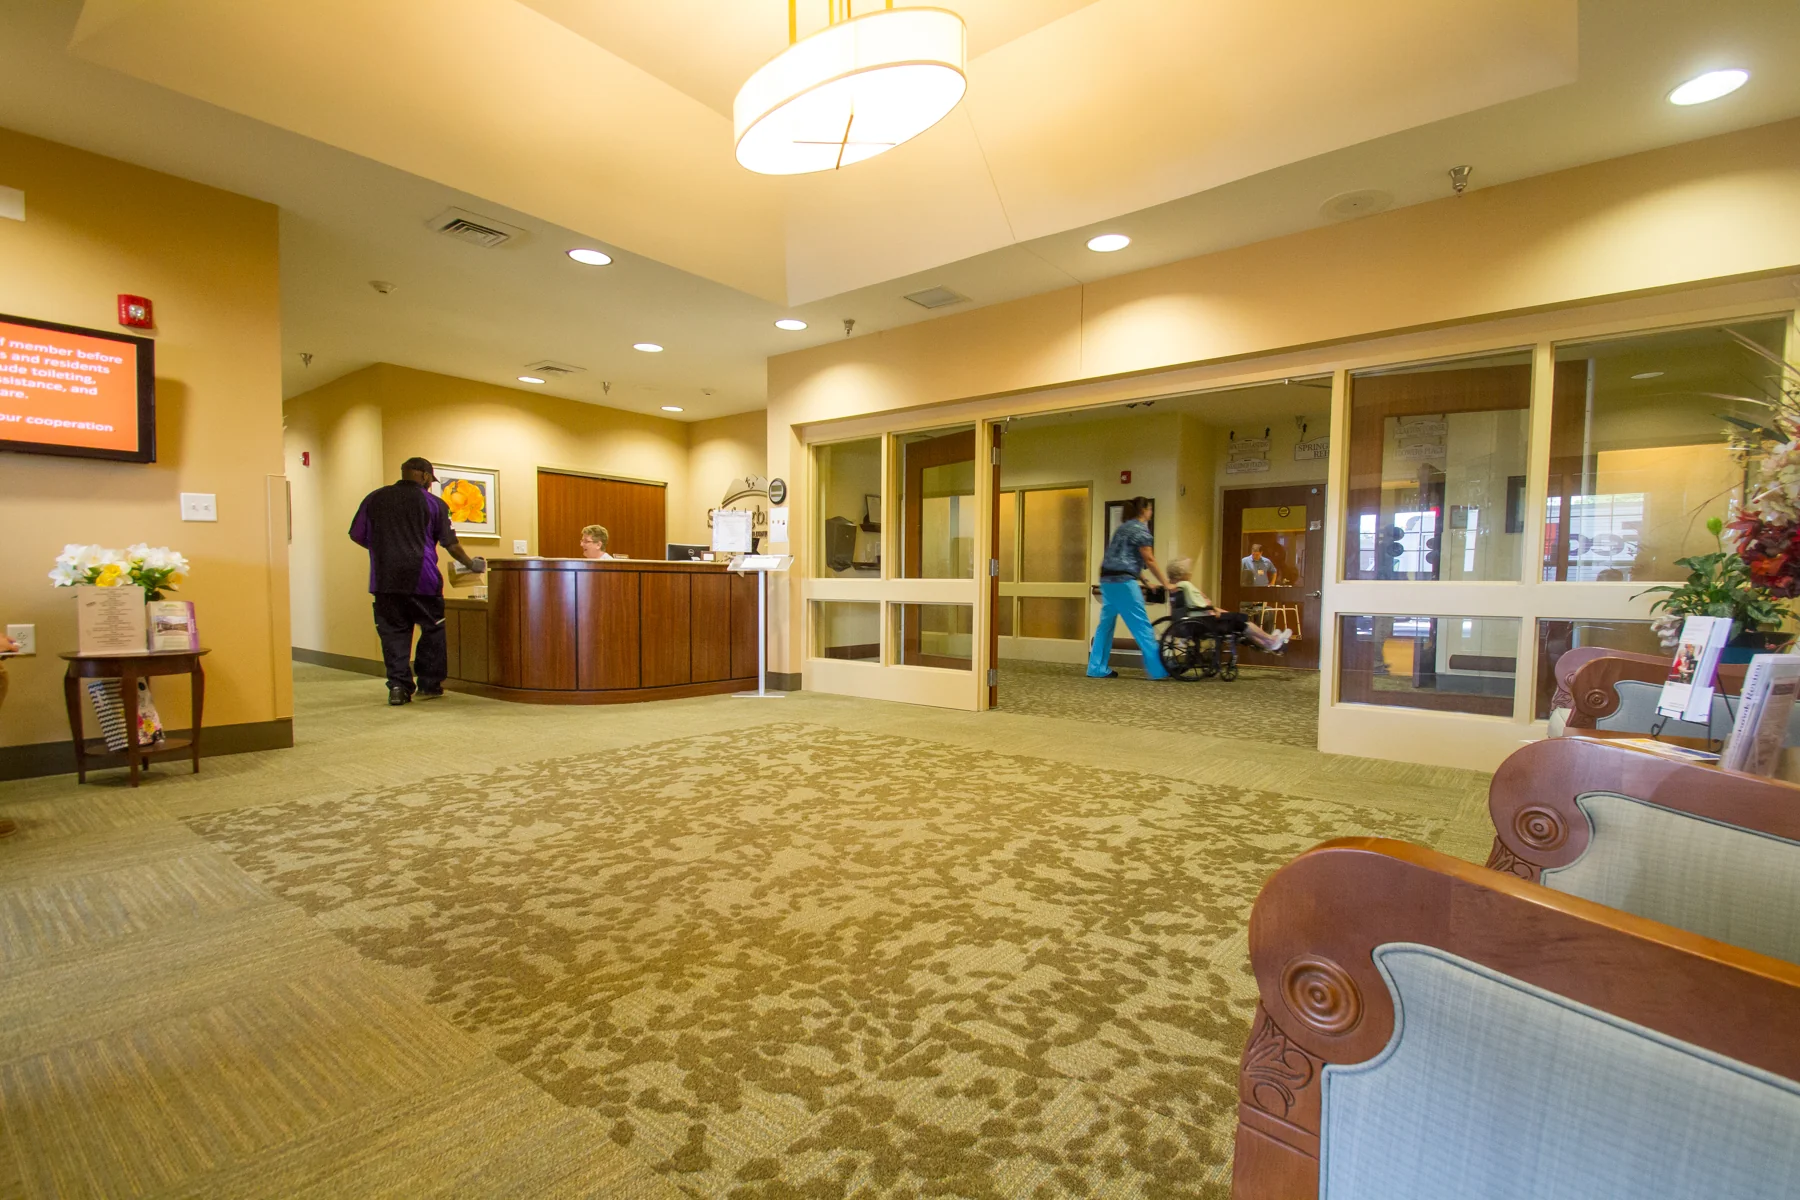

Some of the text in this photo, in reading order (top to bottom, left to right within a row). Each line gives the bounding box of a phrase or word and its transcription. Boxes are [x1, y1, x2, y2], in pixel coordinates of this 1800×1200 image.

[8, 340, 74, 356] member
[76, 349, 123, 364] before
[11, 353, 40, 364] and
[44, 358, 110, 374] residents
[31, 367, 96, 385] toileting,
[70, 386, 98, 395] and
[25, 416, 113, 432] cooperation
[1298, 442, 1328, 452] SPRING
